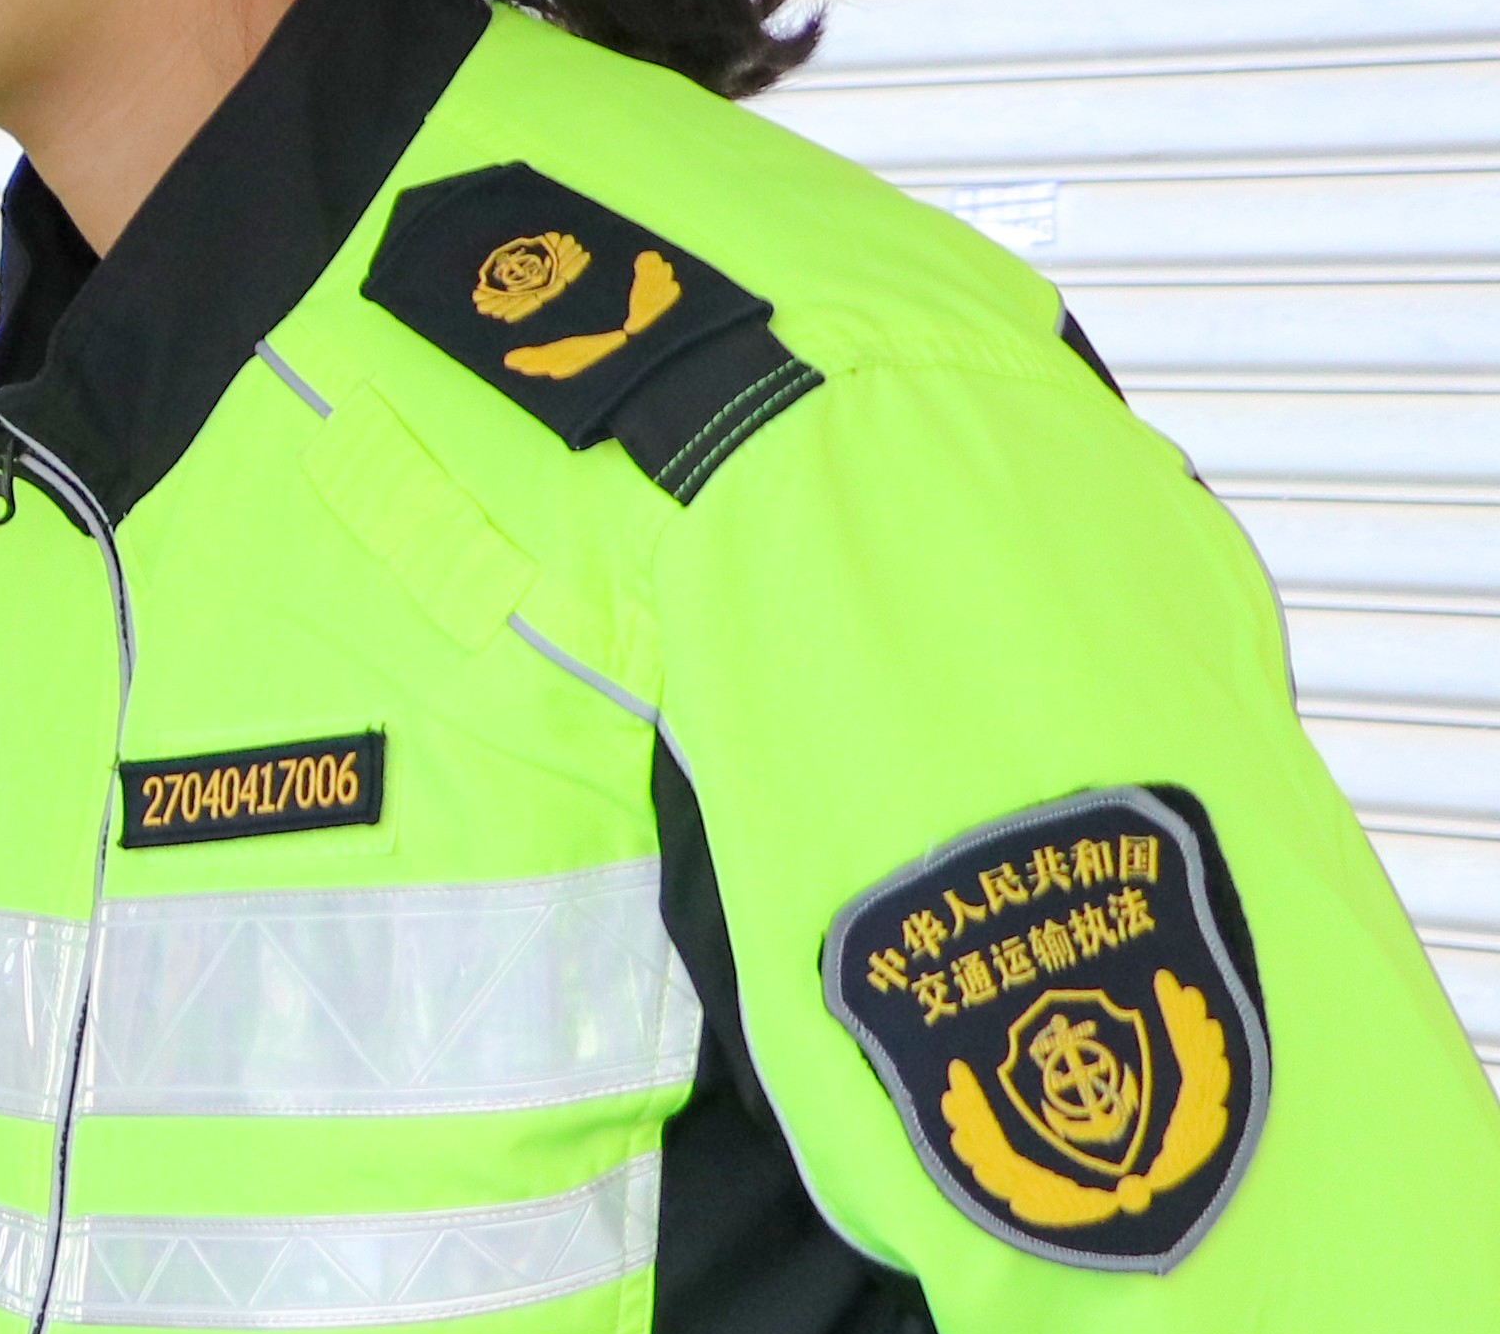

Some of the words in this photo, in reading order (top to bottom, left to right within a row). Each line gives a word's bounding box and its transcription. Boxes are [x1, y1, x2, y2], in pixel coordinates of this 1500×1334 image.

[141, 751, 358, 828] 27040417006
[866, 833, 1160, 996] 中华人民共和国
[911, 885, 1157, 1027] 交通运输执法
